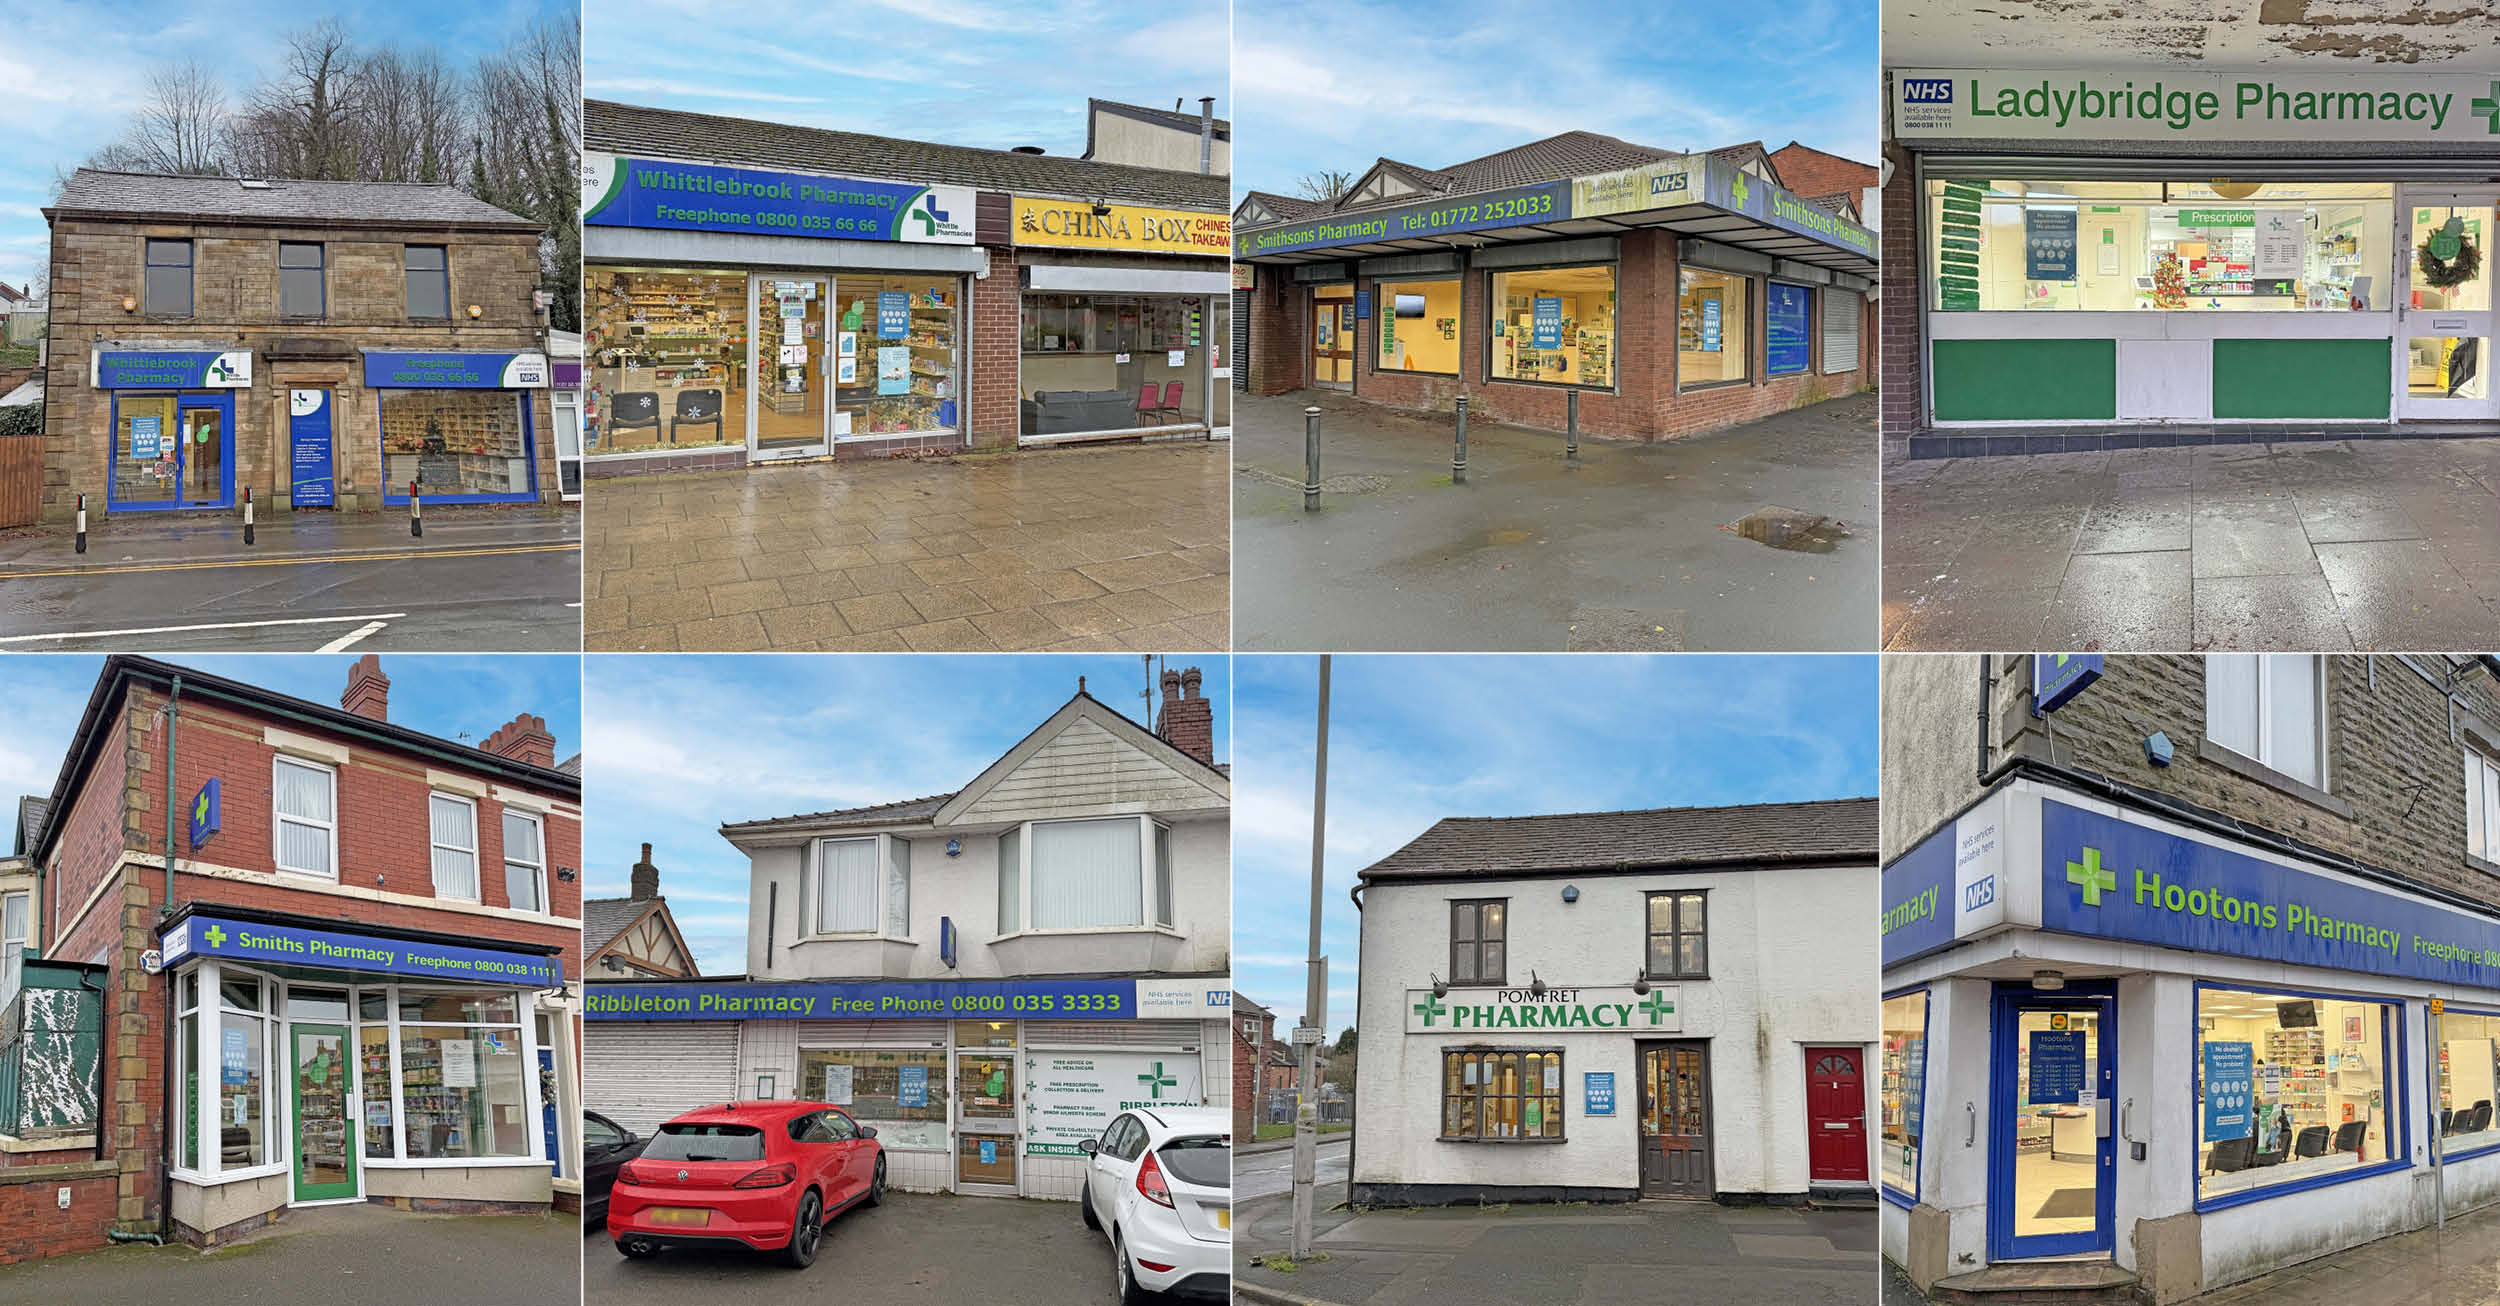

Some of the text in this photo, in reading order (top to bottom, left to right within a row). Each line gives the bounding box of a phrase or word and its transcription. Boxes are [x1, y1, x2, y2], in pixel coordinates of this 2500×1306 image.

[1905, 82, 1950, 99] NHS
[1904, 106, 1952, 114] NHS services
[1971, 79, 2453, 131] Ladybridge Pharmacy
[636, 169, 899, 211] Whittlebrook Pharmacy
[1652, 174, 1686, 193] NHS
[656, 205, 878, 233] Freephone 0800 035 66 66
[1042, 209, 1192, 243] CHINA BOX
[1256, 195, 1552, 249] Smithsons Pharmacy Tel: 01772 252033
[1773, 191, 1872, 253] Smithsons Pharmacy
[2192, 211, 2255, 225] Prescription
[936, 222, 973, 237] Whittle Pharmacies
[105, 357, 197, 369] Whittlebrook
[406, 359, 465, 369] Freephone
[117, 373, 186, 385] Pharmacy
[393, 372, 419, 382] 0800
[423, 372, 445, 382] 035
[521, 373, 539, 382] NHS
[1974, 824, 1995, 844] services
[1967, 877, 1993, 909] NHS
[1882, 884, 1939, 936] armacy
[2135, 869, 2277, 928] Hootons
[2287, 903, 2400, 956] Pharmacy
[2413, 935, 2481, 964] Freephone
[239, 932, 556, 977] Smiths Pharmacy Freephone 0800 038 1111
[586, 994, 1121, 1015] Ribbleton Pharmacy Free Phone 0800 035 3333
[1498, 989, 1581, 1004] POMFRET
[1453, 1004, 1634, 1028] PHARMACY
[1028, 1144, 1080, 1154] ASK INSIDE
